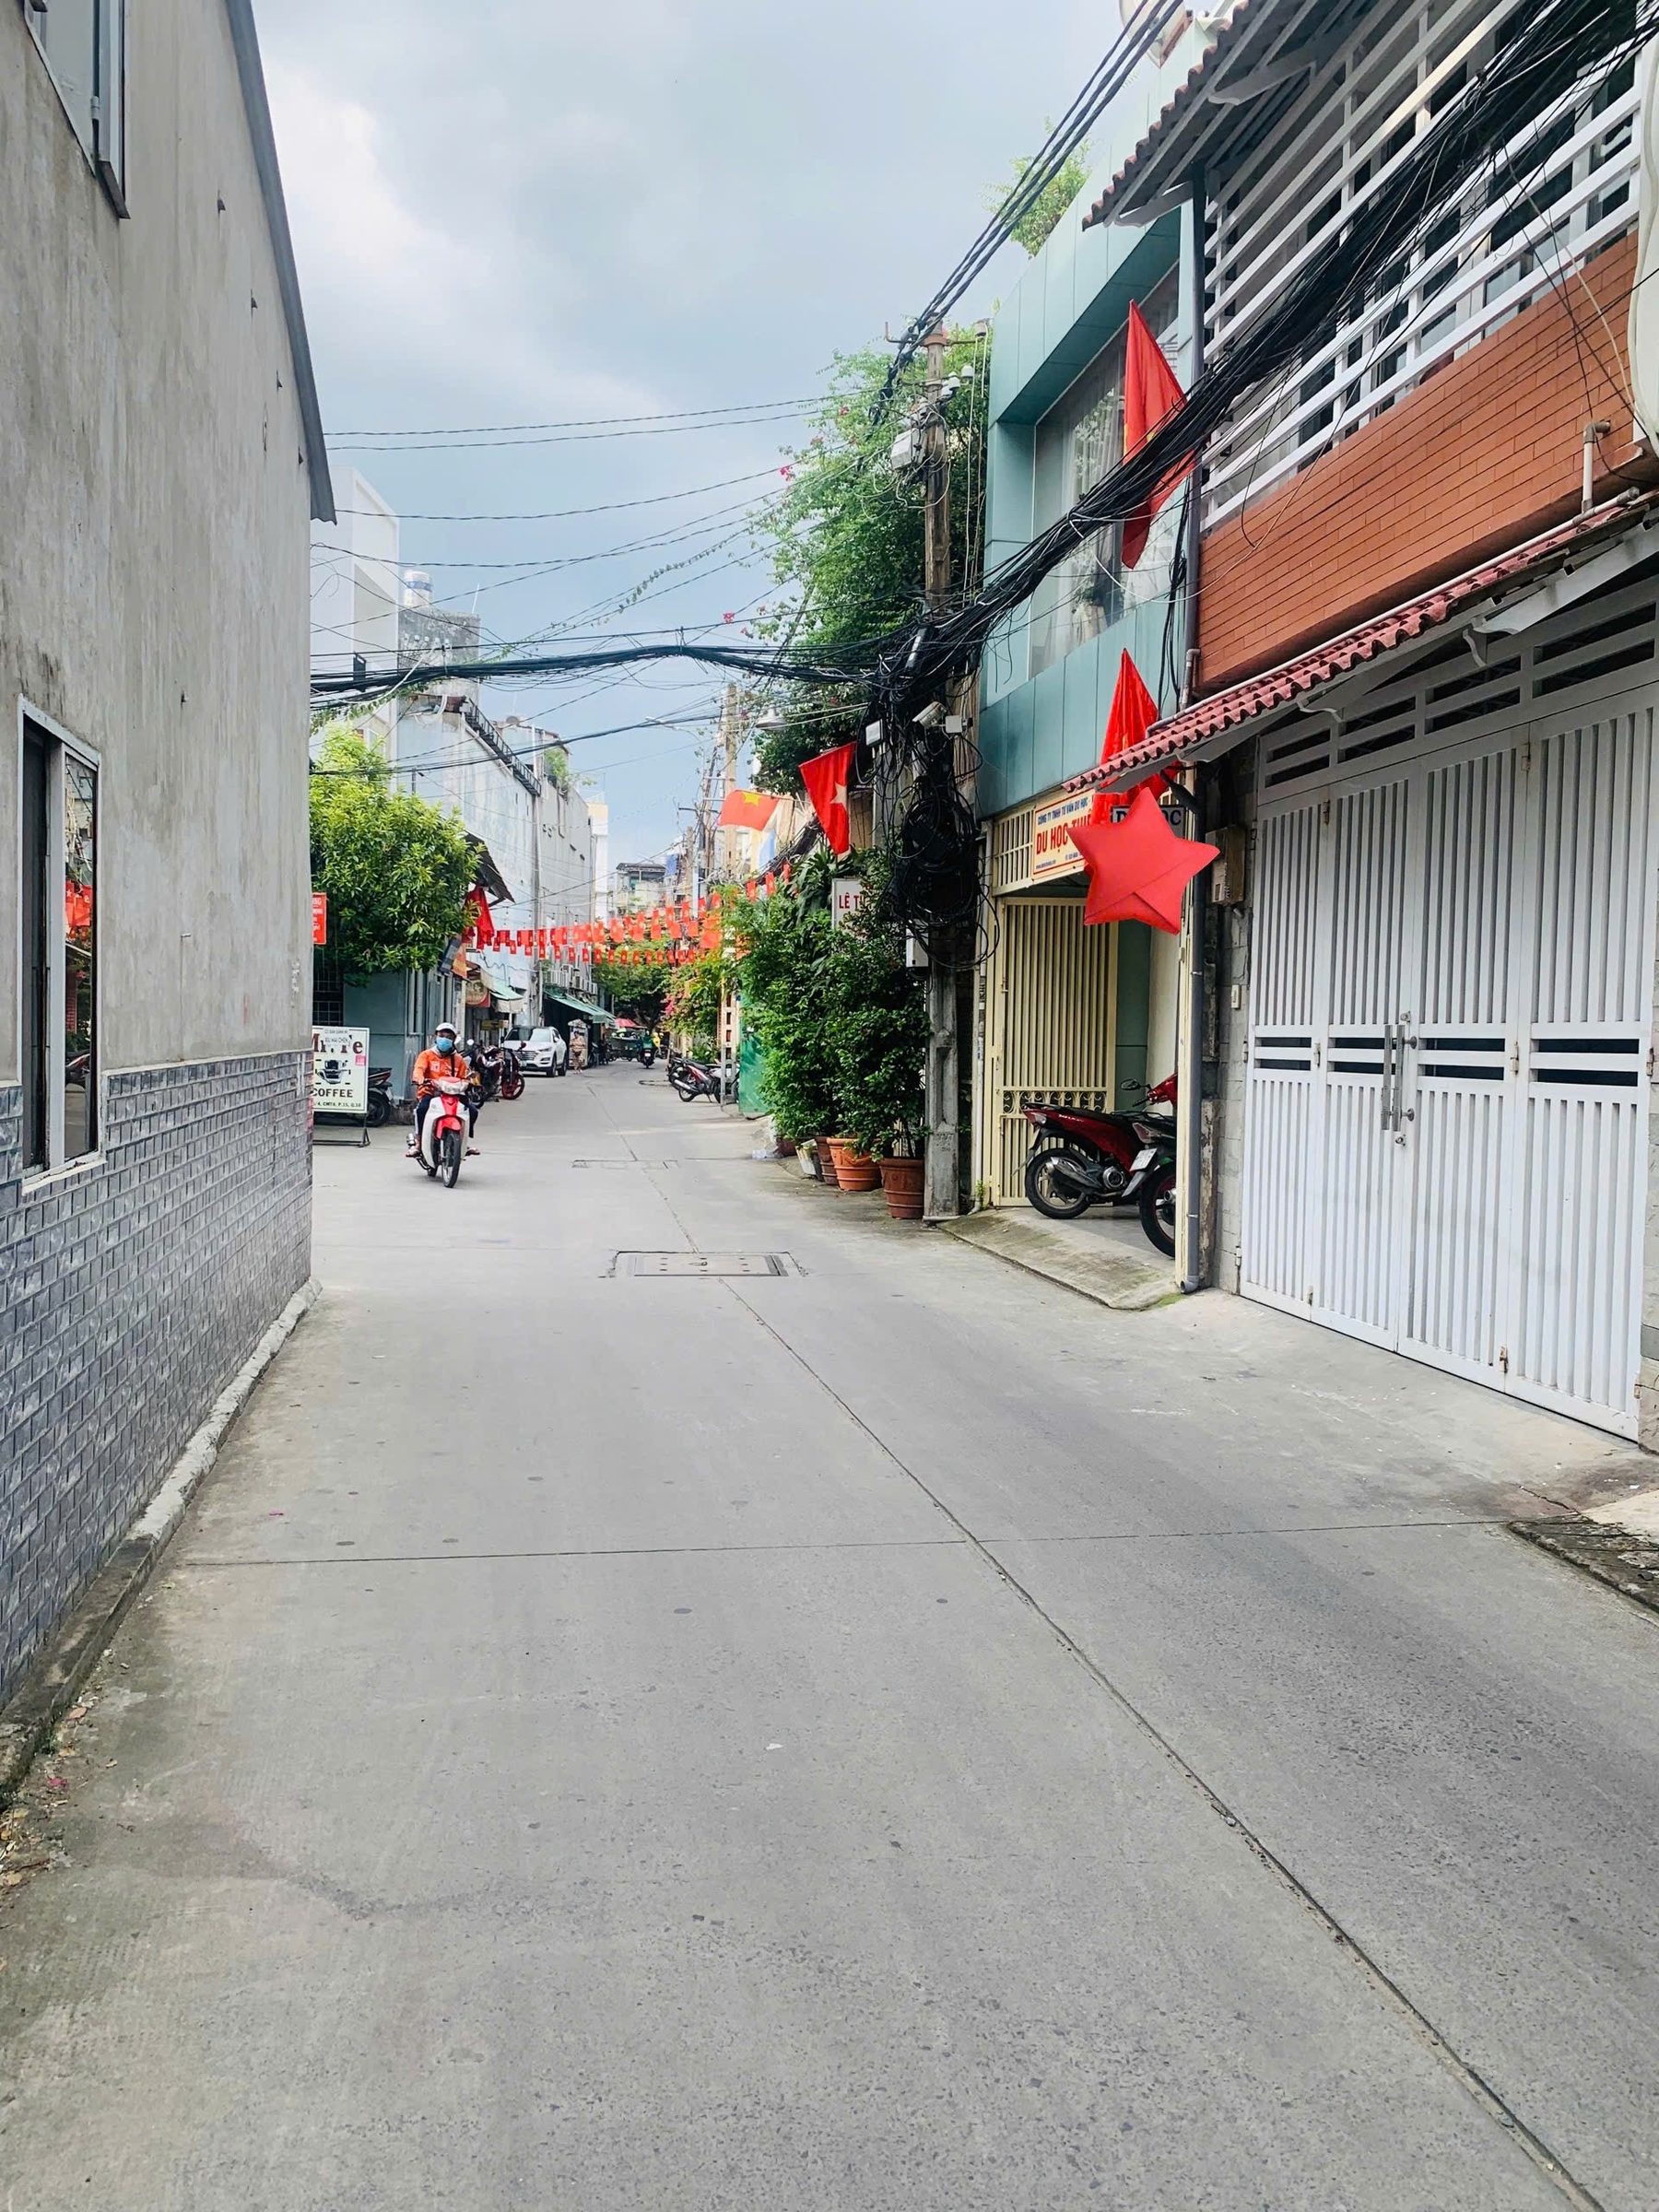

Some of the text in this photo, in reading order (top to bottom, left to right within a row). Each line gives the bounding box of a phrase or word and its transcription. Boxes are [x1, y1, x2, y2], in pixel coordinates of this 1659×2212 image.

[1036, 822, 1069, 855] DU HỌC
[839, 891, 850, 910] LÊ
